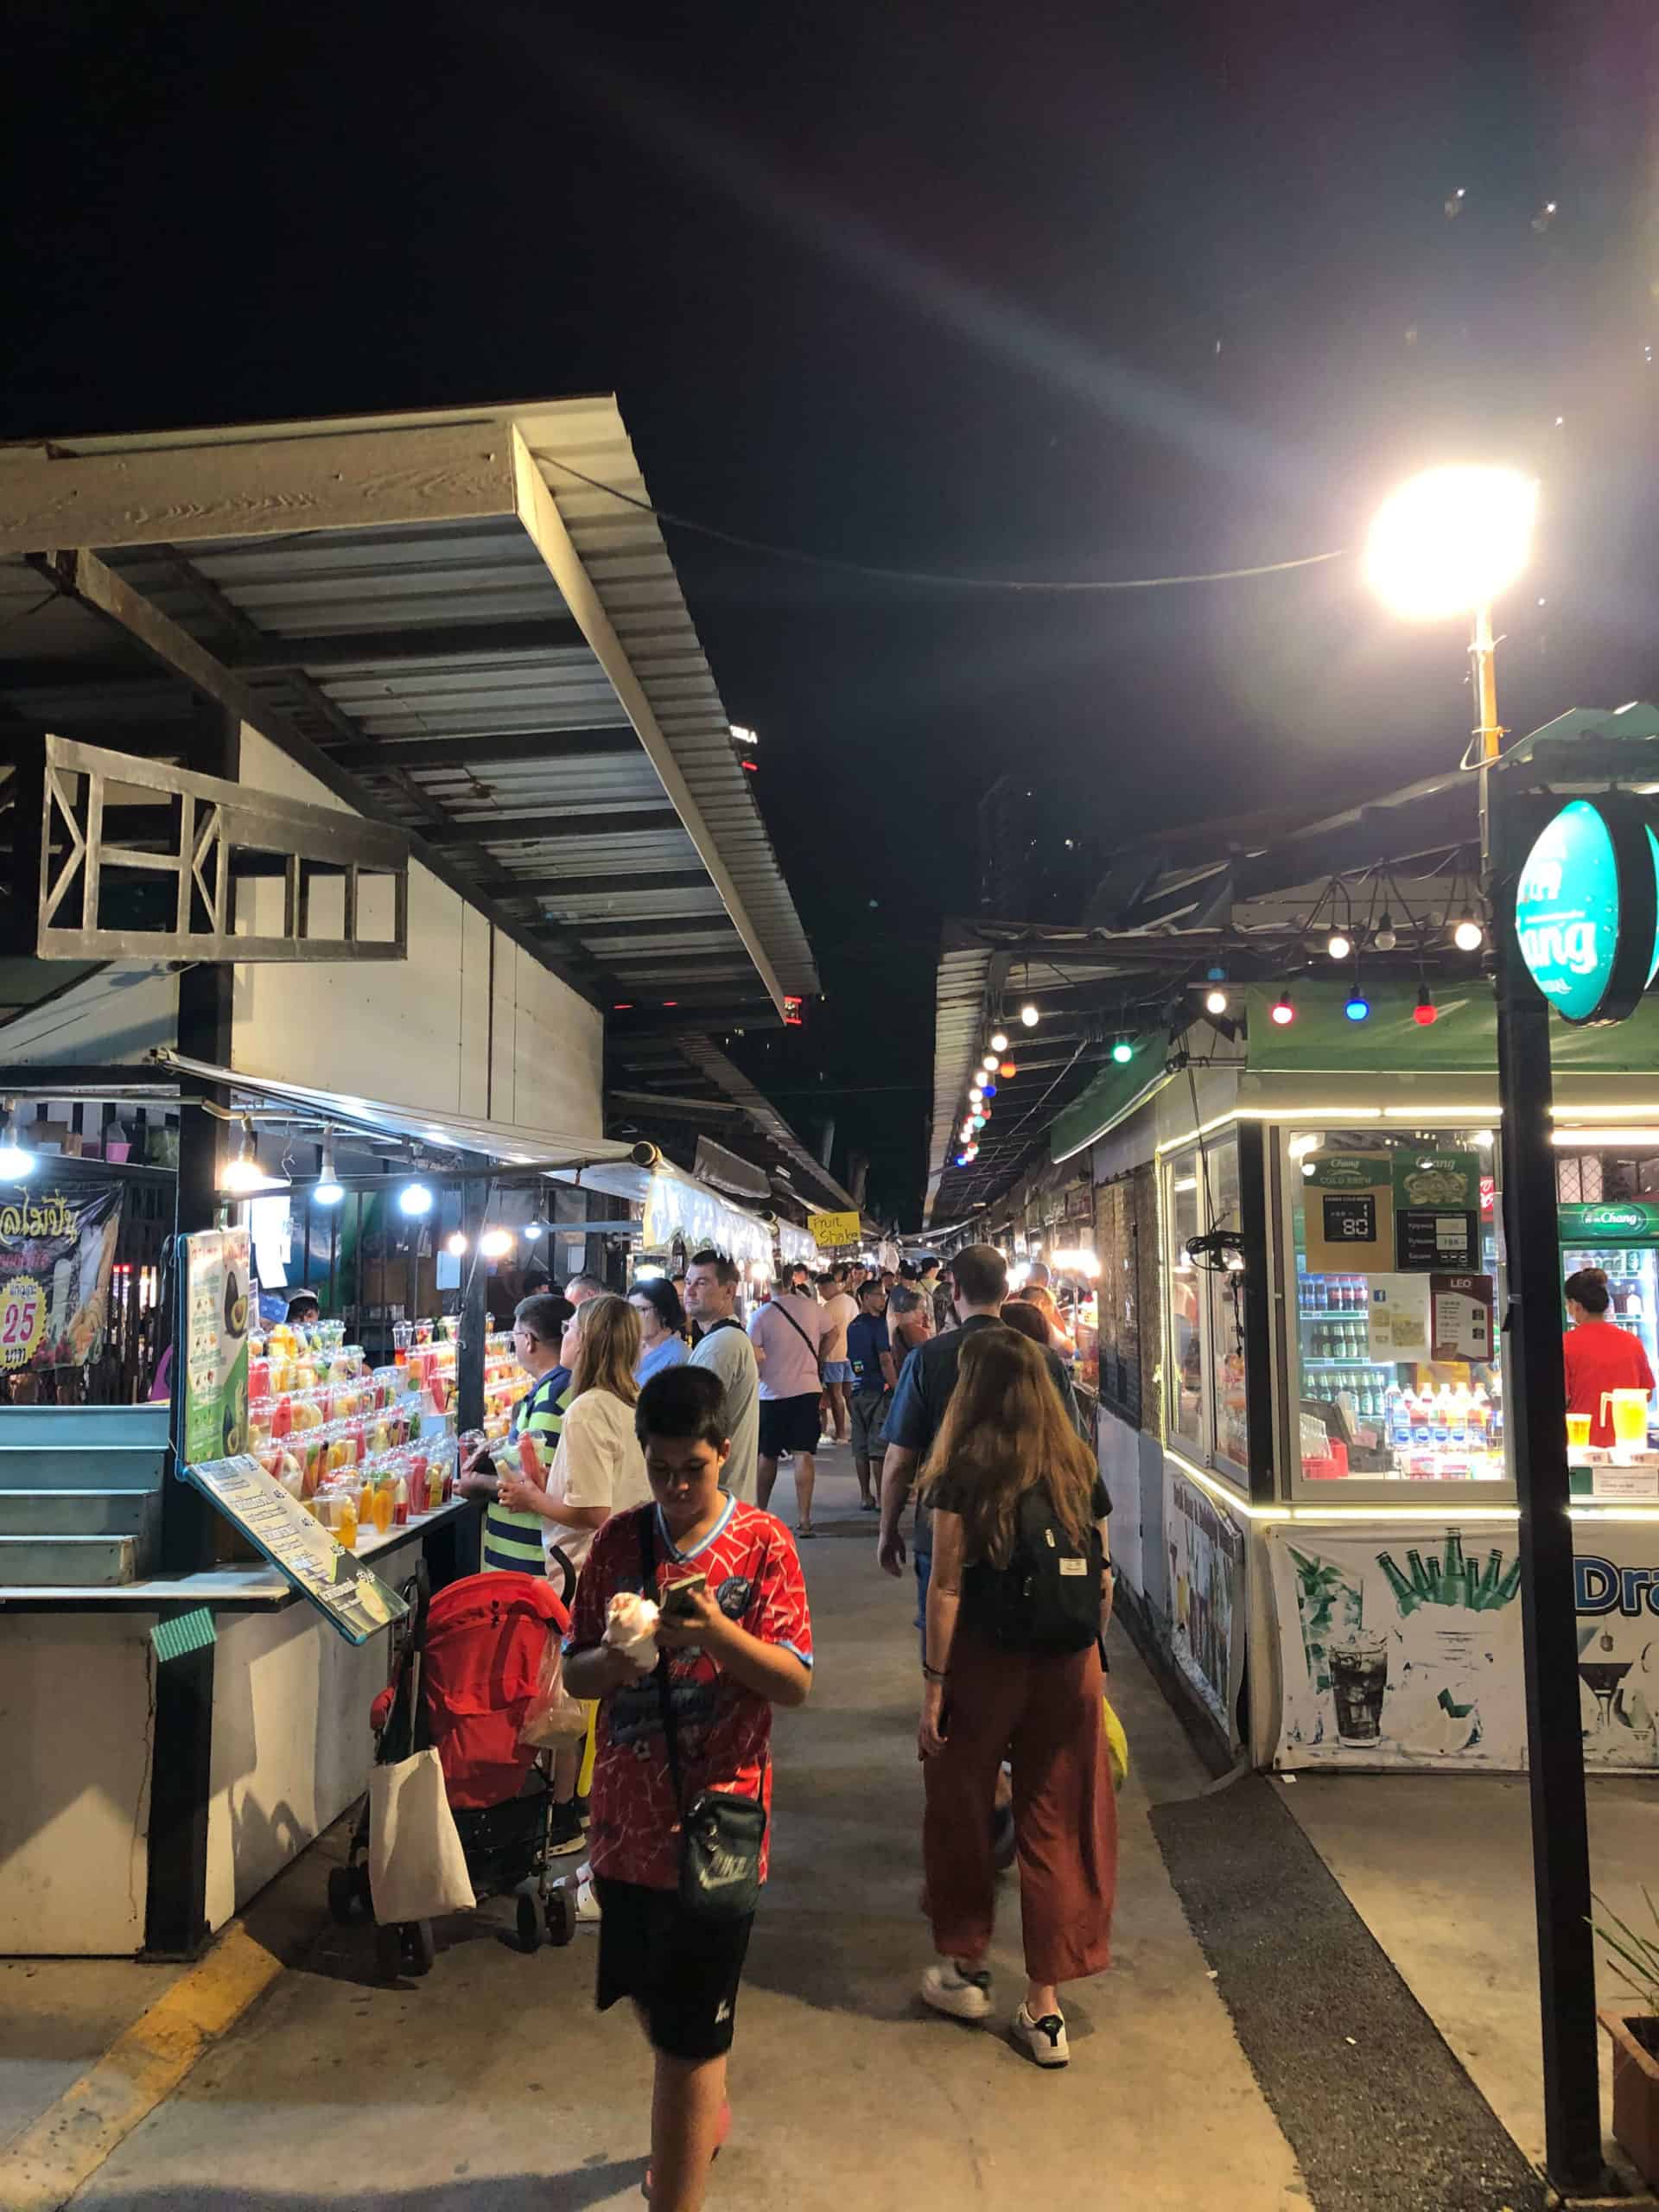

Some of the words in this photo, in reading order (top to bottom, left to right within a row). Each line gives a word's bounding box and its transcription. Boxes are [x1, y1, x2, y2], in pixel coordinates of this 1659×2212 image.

[1415, 1156, 1456, 1169] Chang
[813, 1217, 842, 1229] Fruit
[1601, 1211, 1637, 1225] Chang
[1343, 1218, 1368, 1235] 80
[1450, 1278, 1471, 1288] LEO
[3, 1302, 36, 1344] 25
[5, 1348, 26, 1363] บาท
